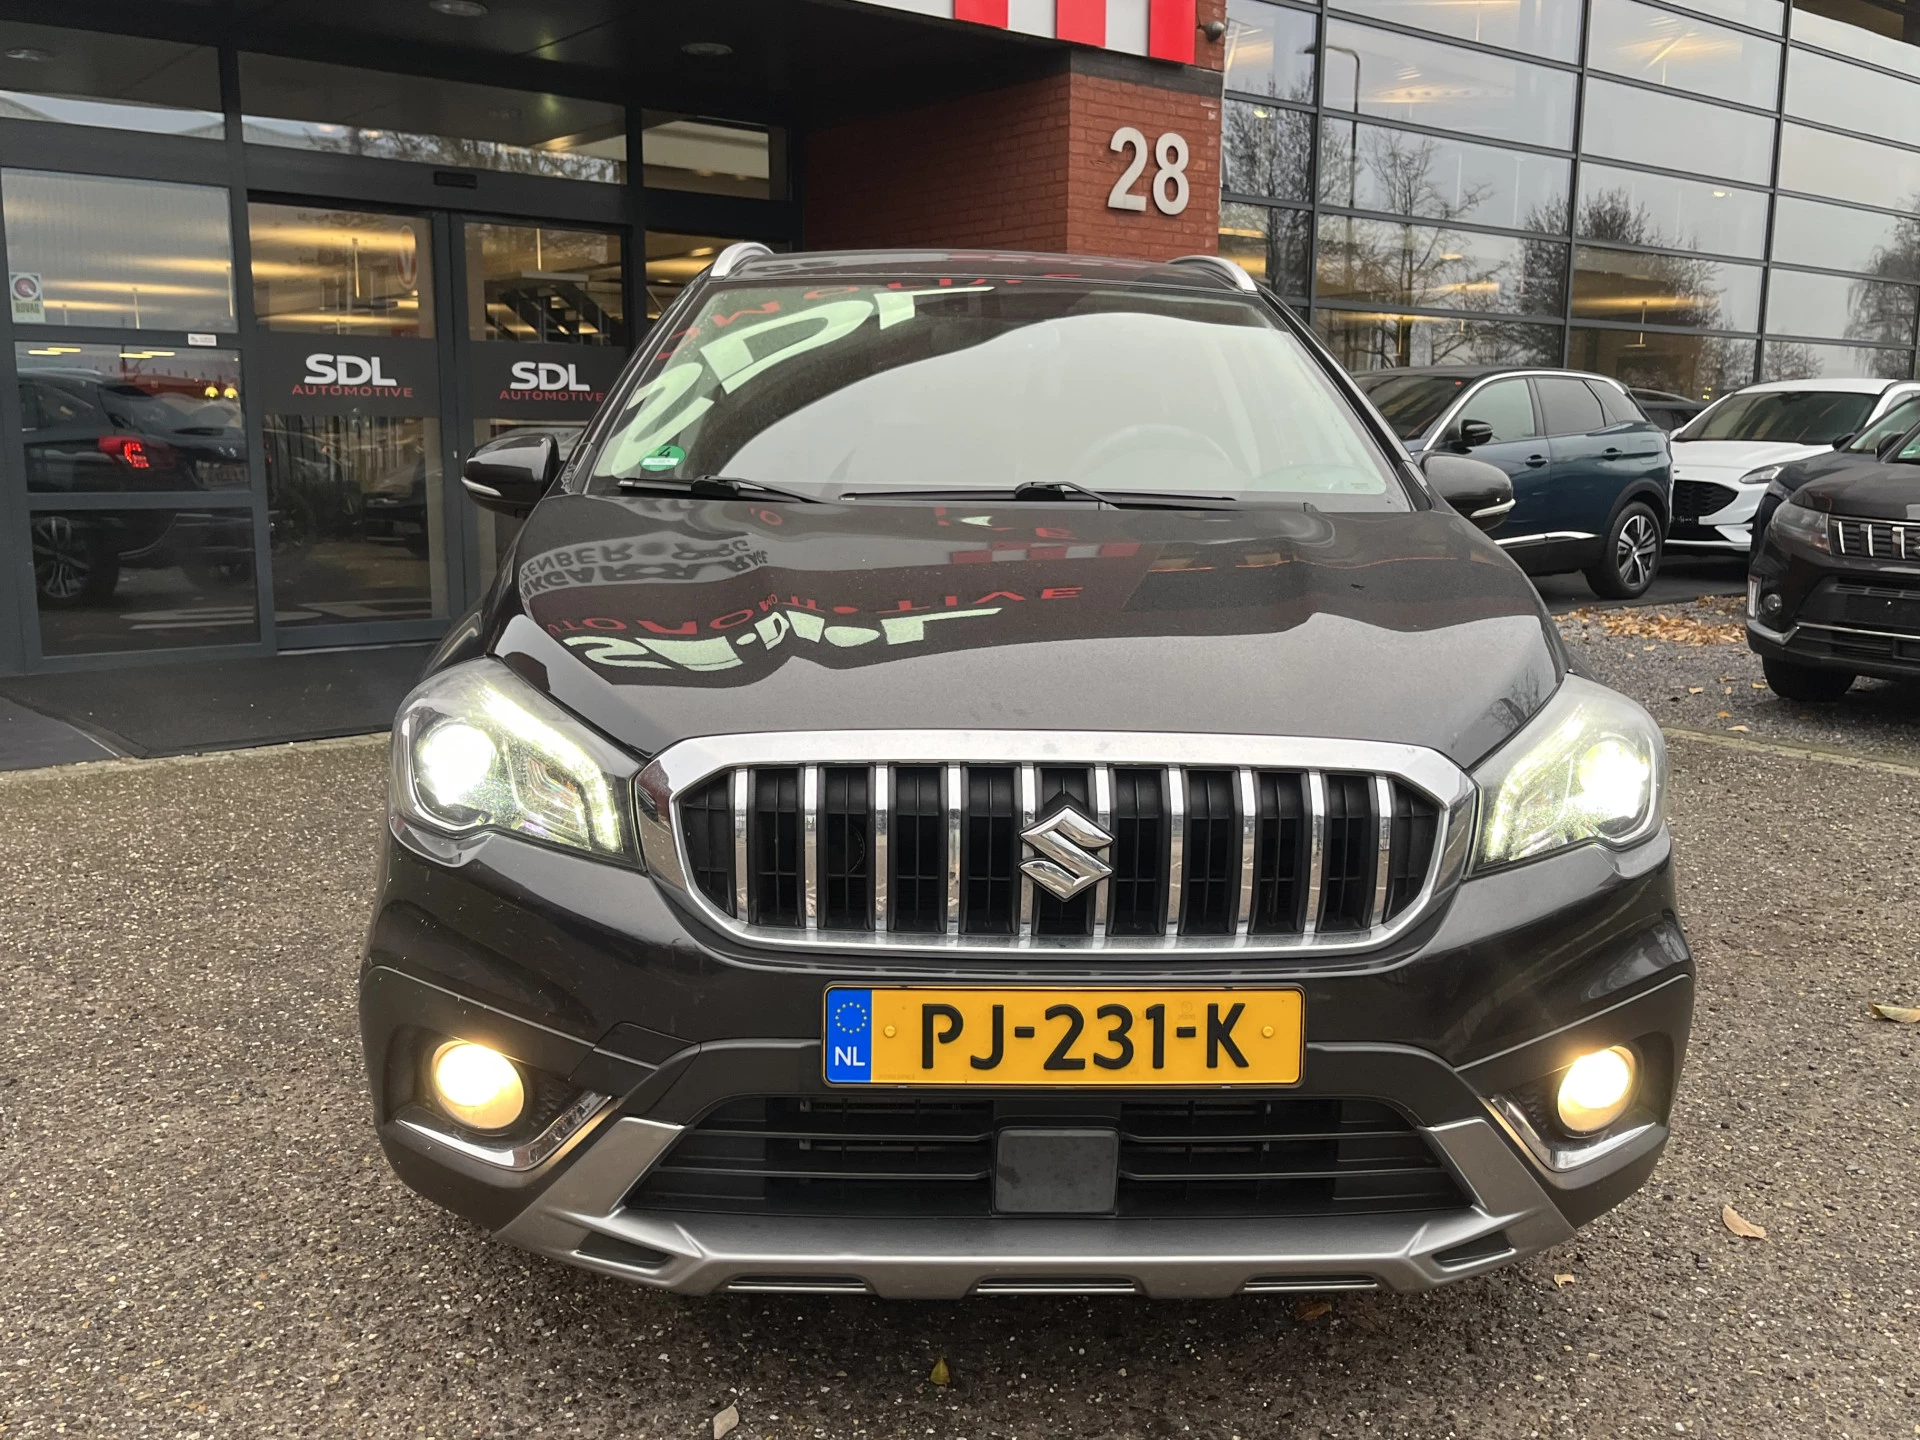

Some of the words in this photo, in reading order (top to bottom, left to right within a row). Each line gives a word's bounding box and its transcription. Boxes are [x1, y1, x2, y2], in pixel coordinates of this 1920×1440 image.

[1107, 126, 1190, 215] 28
[303, 353, 397, 386] SDL
[510, 361, 591, 391] SDL
[292, 384, 413, 398] AUTOMOTIVE
[500, 389, 605, 402] AUTOMOTIVE
[658, 446, 671, 457] 4
[921, 1003, 1250, 1071] PJ-231-K
[834, 1046, 866, 1066] NL
